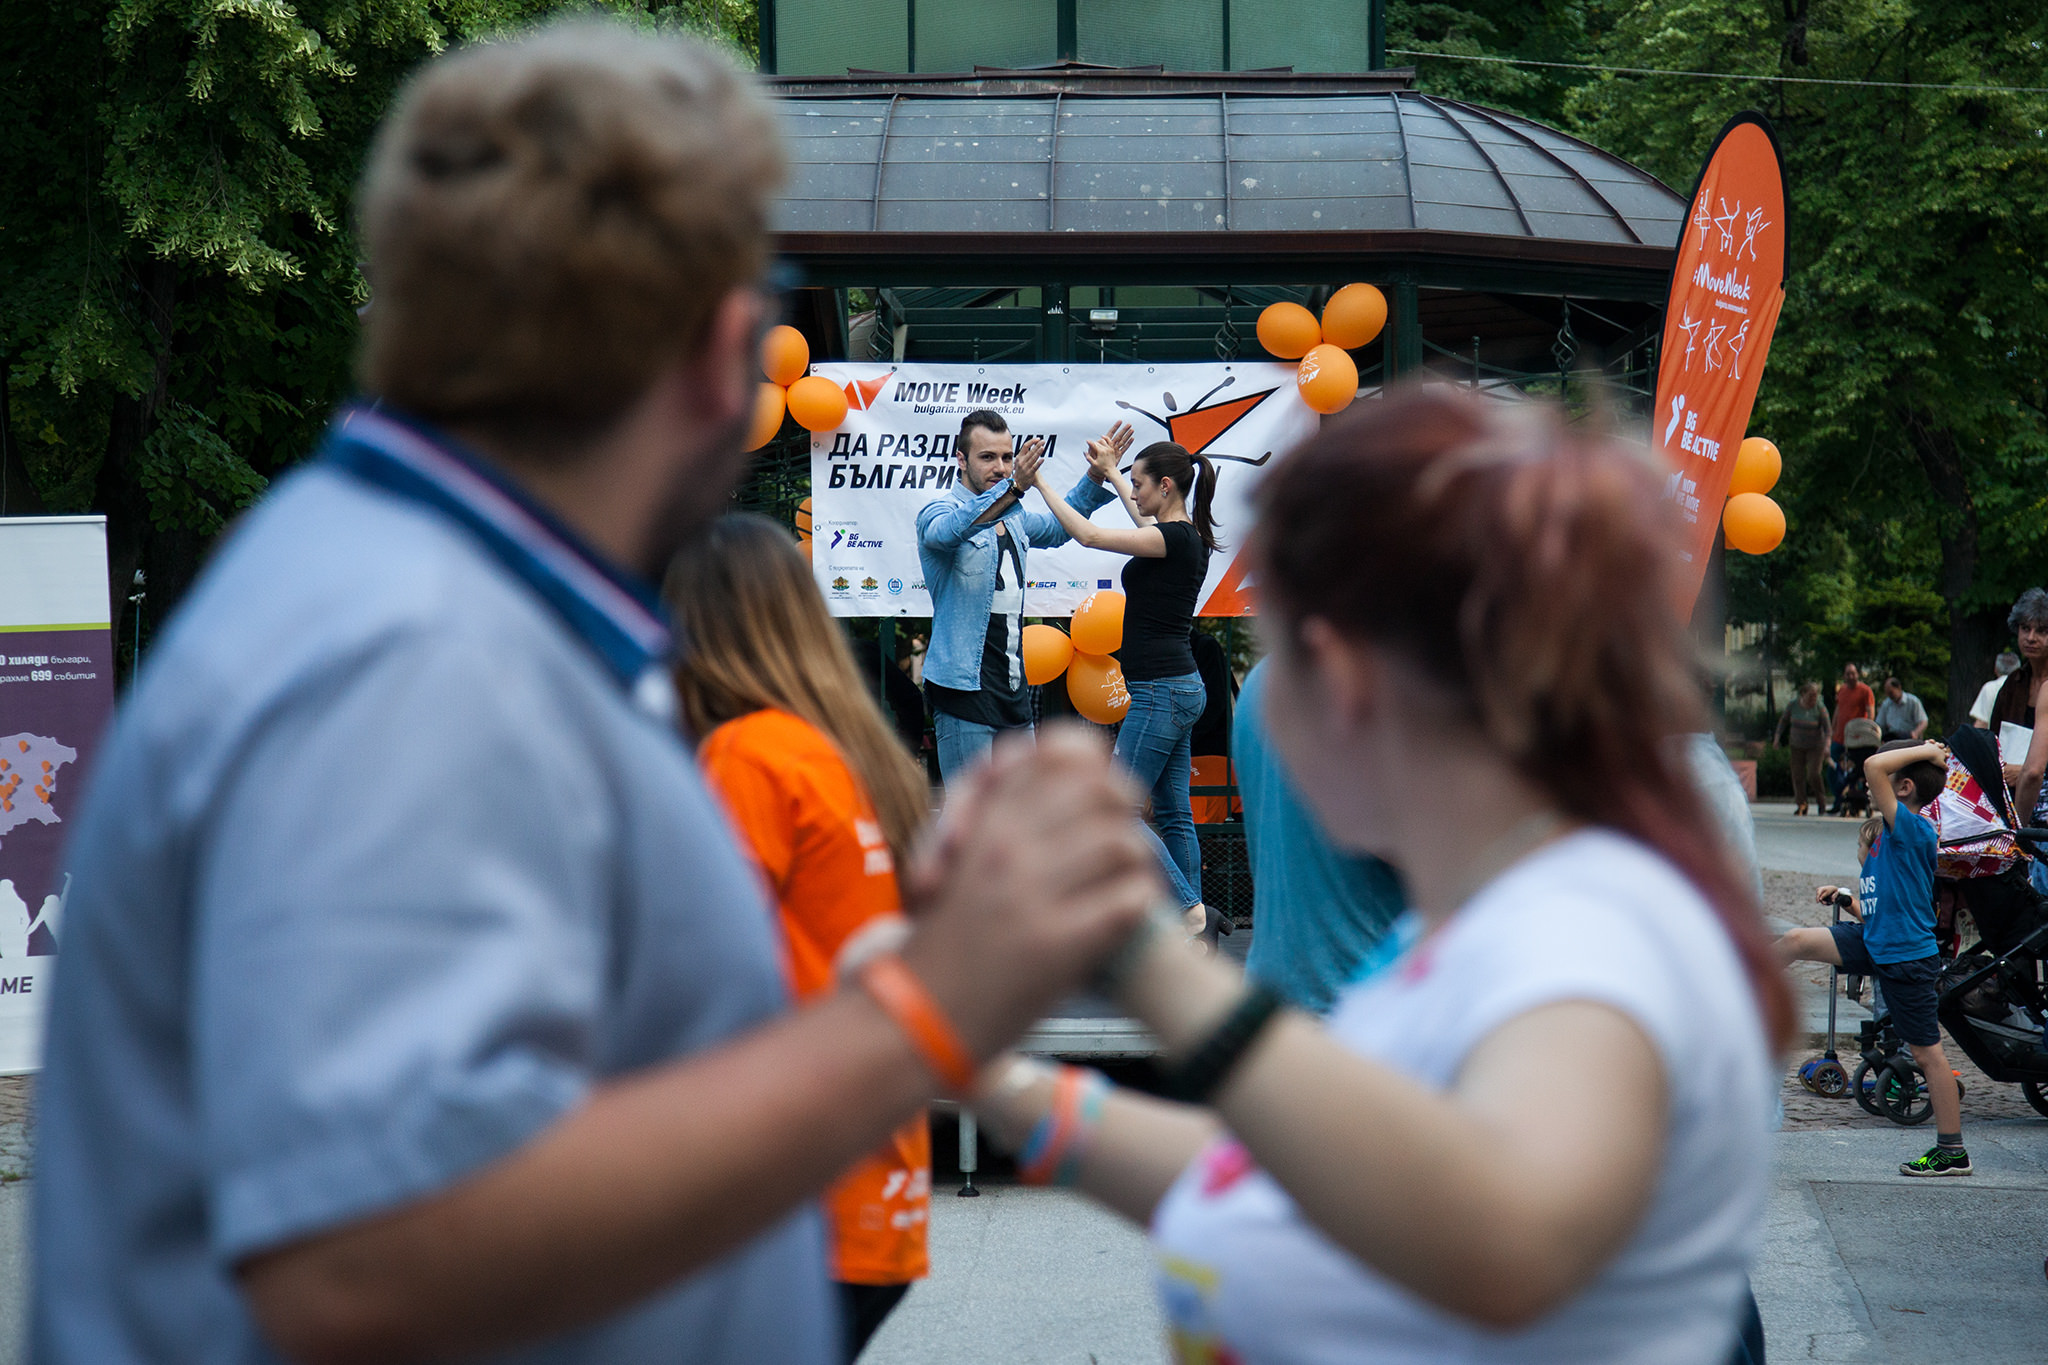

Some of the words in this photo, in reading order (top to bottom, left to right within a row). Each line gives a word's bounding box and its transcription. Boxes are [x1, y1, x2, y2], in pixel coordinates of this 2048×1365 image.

[894, 382, 960, 402] MOVE
[967, 383, 1027, 404] Week
[1685, 410, 1698, 431] BG
[828, 433, 868, 461] ДА
[1681, 430, 1693, 451] BE
[828, 464, 961, 489] БЪЛГАРИ
[847, 540, 857, 548] BE
[857, 540, 883, 548] ACTIVE
[8, 655, 49, 667] хиляди
[31, 670, 52, 681] 699
[54, 672, 96, 681] събития
